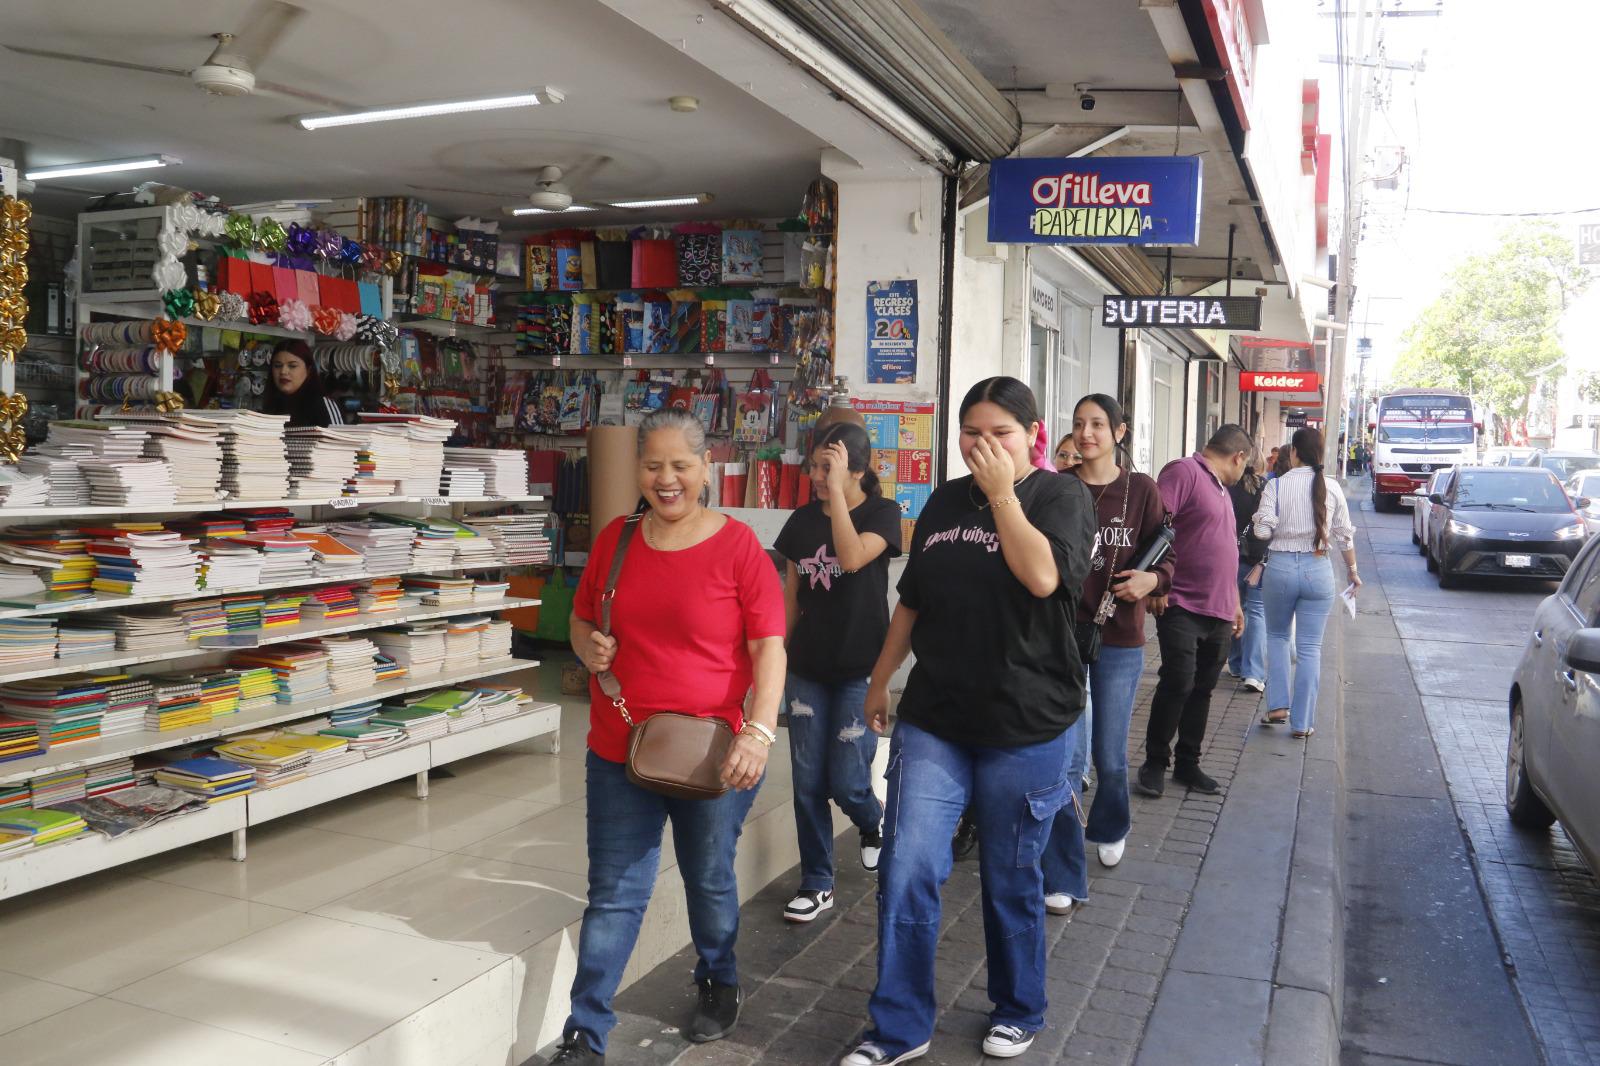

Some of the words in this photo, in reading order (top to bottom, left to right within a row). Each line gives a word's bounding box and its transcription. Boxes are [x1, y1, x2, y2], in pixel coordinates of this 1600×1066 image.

[1032, 173, 1151, 208] Ofilleva
[874, 297, 913, 306] REGRESO
[877, 306, 911, 316] CLASES
[899, 416, 906, 426] 3
[877, 450, 884, 459] 5
[911, 451, 919, 461] 6
[1098, 526, 1135, 547] YORK
